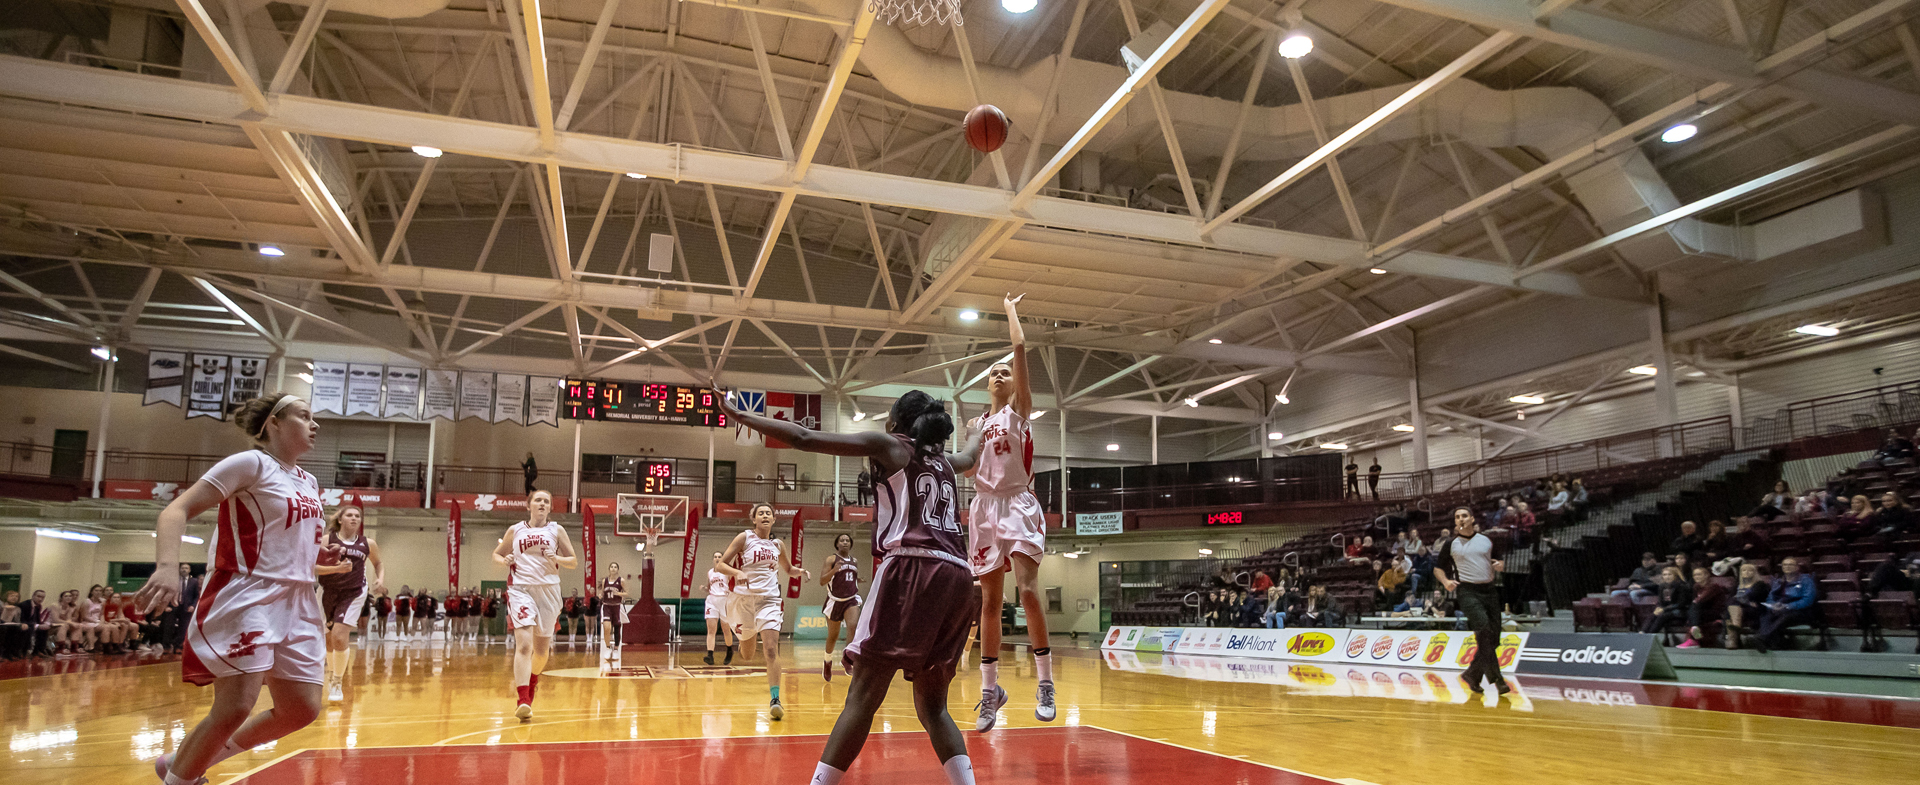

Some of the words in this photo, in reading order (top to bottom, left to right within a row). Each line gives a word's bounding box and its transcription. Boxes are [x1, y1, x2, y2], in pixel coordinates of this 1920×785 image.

[233, 377, 261, 390] MEMBER
[570, 386, 581, 398] 14
[587, 386, 595, 399] 2
[603, 388, 622, 404] 41
[642, 384, 668, 400] 1:55
[658, 399, 666, 413] 2
[676, 393, 695, 408] 29
[702, 394, 712, 406] 13
[587, 407, 595, 419] 4
[718, 414, 726, 426] 5
[993, 440, 1011, 456] 24
[649, 464, 670, 477] 1:55
[644, 477, 664, 493] 21
[914, 472, 964, 535] 22
[519, 538, 550, 554] Hawks
[845, 572, 854, 581] 12
[1348, 642, 1366, 653] KING
[1350, 637, 1368, 646] BURGER
[1375, 638, 1394, 647] BURGER
[1401, 639, 1421, 648] BURGER
[1372, 643, 1392, 654] KING
[1399, 644, 1419, 655] KING
[1426, 645, 1445, 663] 8
[1459, 646, 1478, 665] 8
[1498, 647, 1516, 666] 8
[1561, 646, 1633, 665] adidas
